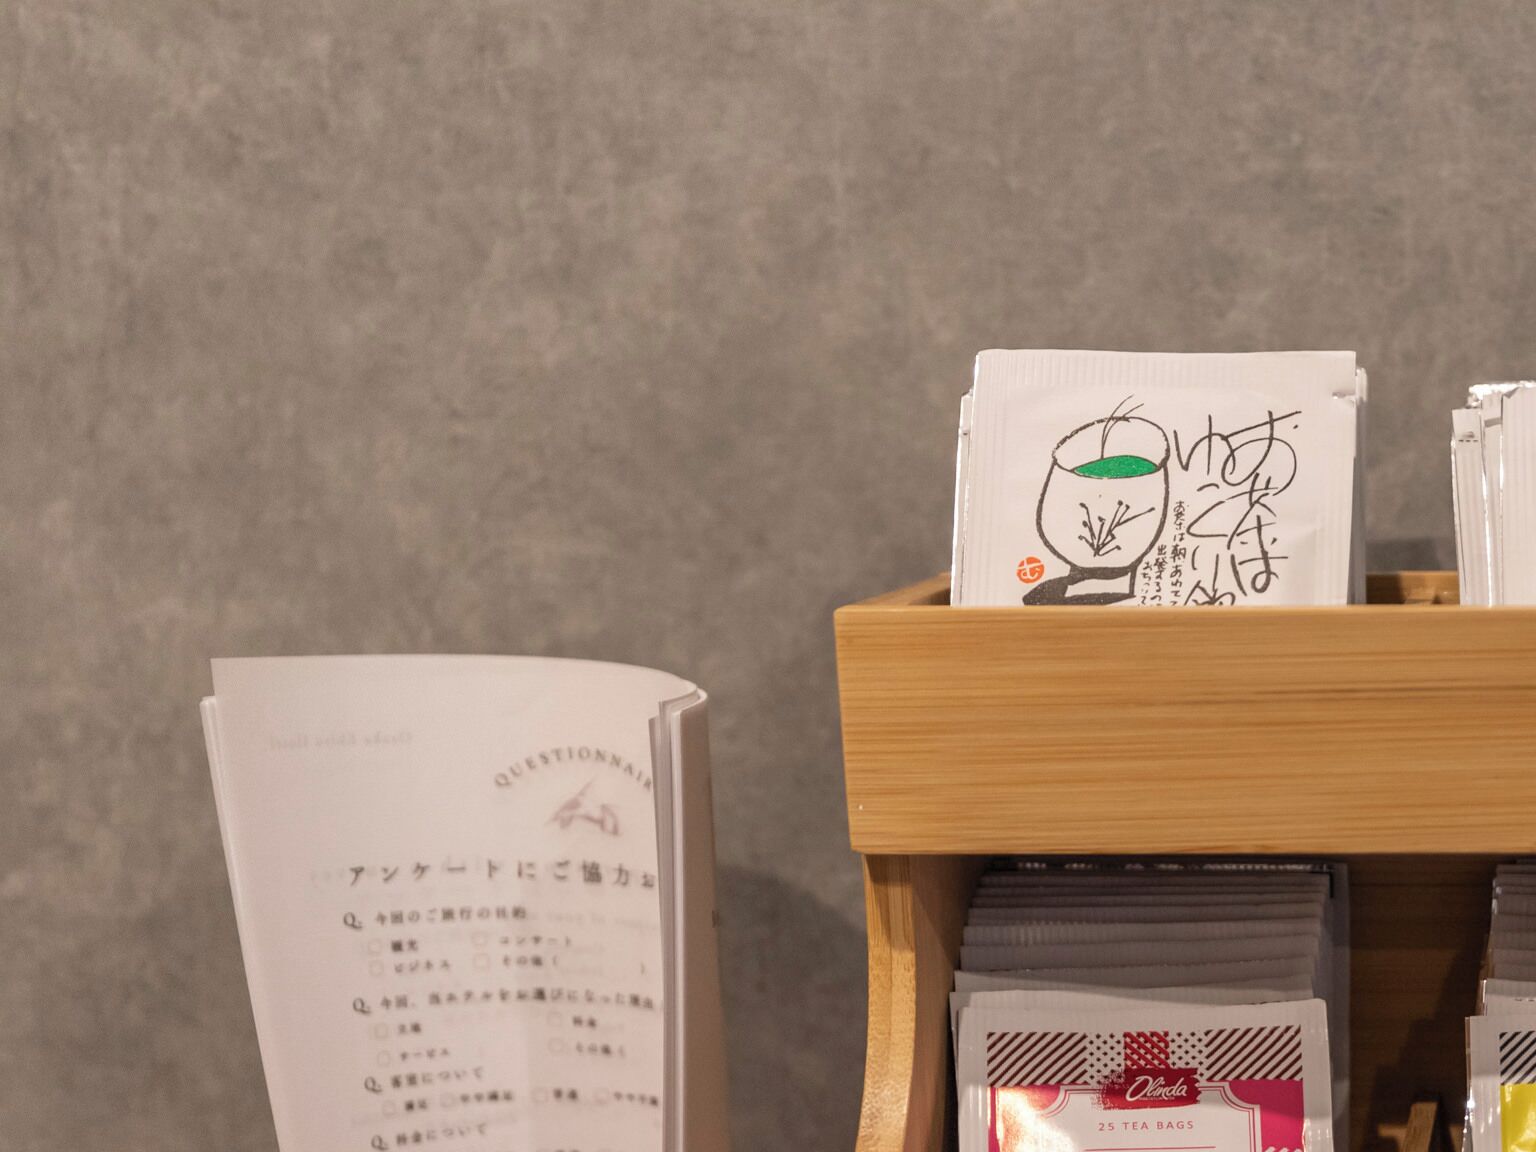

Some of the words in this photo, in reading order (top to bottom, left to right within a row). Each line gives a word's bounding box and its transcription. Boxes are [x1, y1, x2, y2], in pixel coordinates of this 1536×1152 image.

[1125, 1075, 1187, 1102] Olinda
[1098, 1122, 1115, 1132] 25
[1123, 1121, 1149, 1131] TEA
[1157, 1120, 1194, 1130] BAGS
